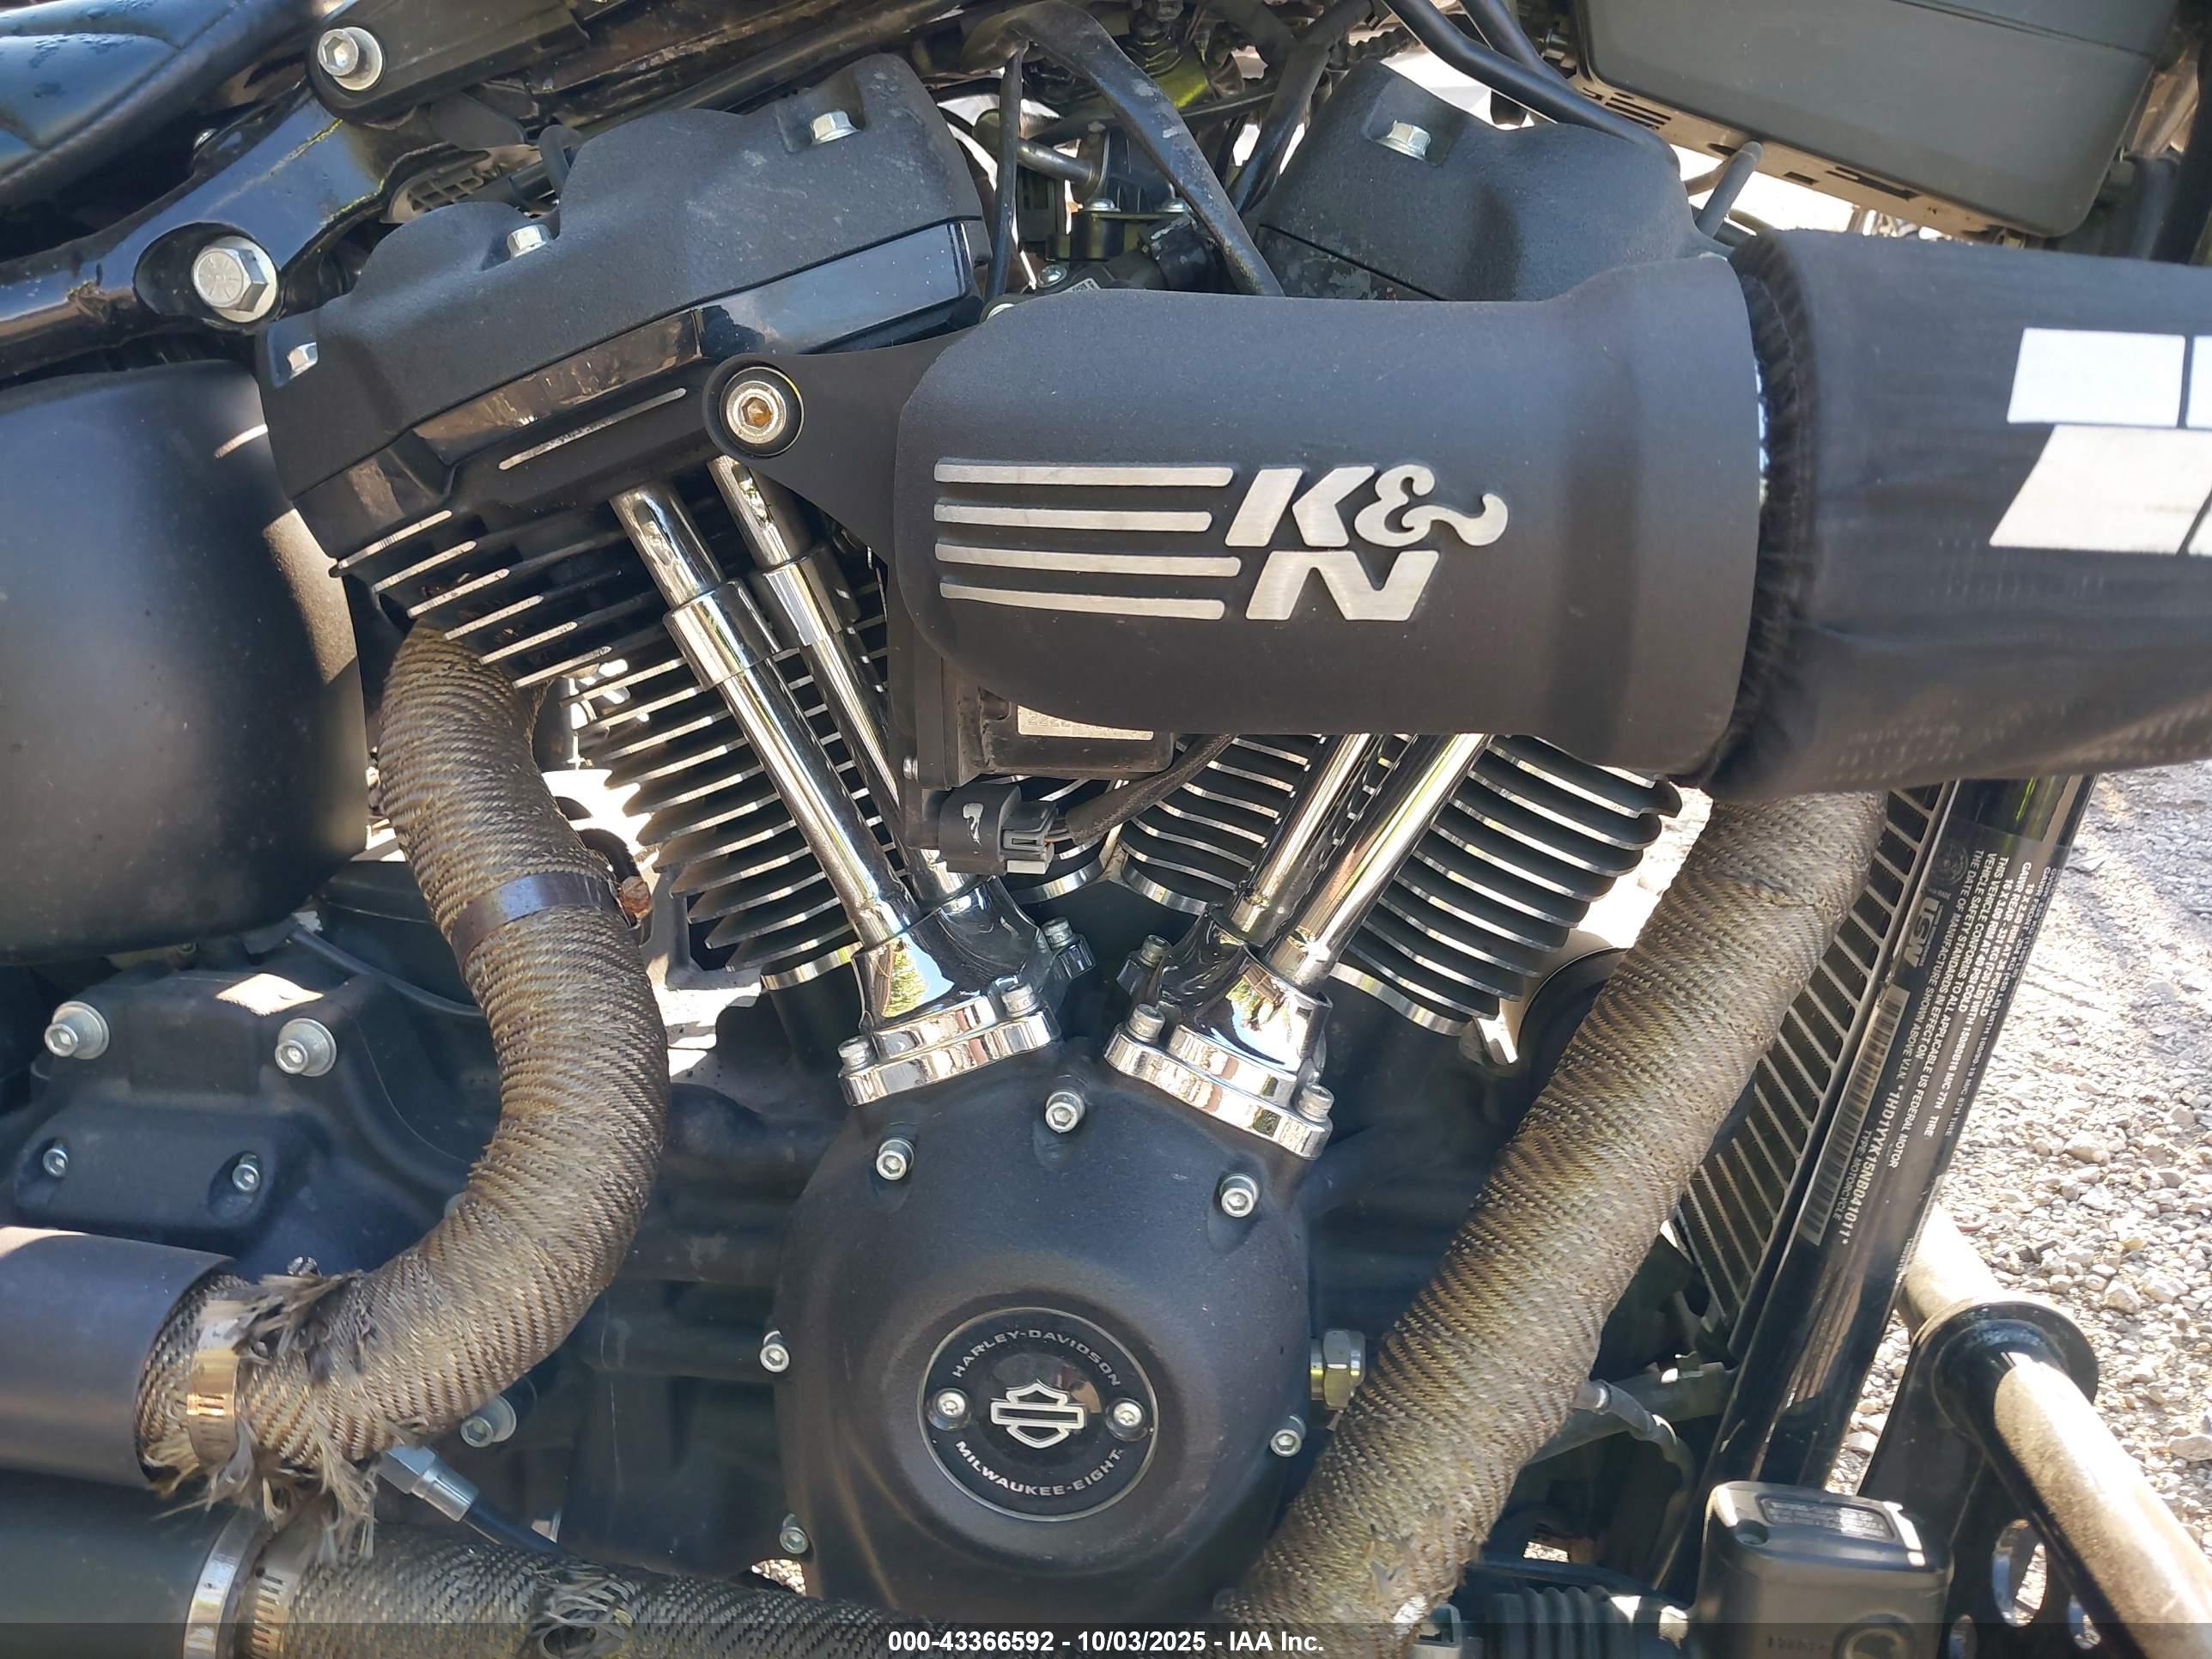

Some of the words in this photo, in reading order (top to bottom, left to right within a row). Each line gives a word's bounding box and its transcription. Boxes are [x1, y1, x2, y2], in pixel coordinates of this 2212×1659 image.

[1970, 850, 1984, 870] THE
[1993, 857, 2009, 879] THIS
[1960, 870, 1977, 897] DATE
[1974, 853, 1997, 896] VEHICLE
[2002, 878, 2014, 890] 16
[2014, 862, 2032, 893] GAWR
[2034, 866, 2051, 896] GAWR
[1999, 890, 2010, 900] X
[2025, 883, 2035, 895] 19
[1955, 897, 1967, 913] OF
[1978, 880, 2001, 922] VEHICLE
[1991, 899, 2007, 920] 3.00
[2003, 893, 2021, 921] REAR
[1961, 896, 1982, 934] SAFETY
[2014, 903, 2027, 924] 2.50
[2022, 898, 2039, 931] FRONT
[1984, 921, 1999, 940] RIM
[1995, 927, 2008, 945] 331
[2007, 925, 2020, 944] RIM
[1928, 913, 1961, 986] MANUFACTURE
[1957, 923, 1984, 979] CONFORMS
[1979, 939, 1991, 955] AT
[1989, 945, 2002, 962] KG
[2001, 944, 2013, 959] AT
[1939, 935, 1967, 994] STANDARDS
[1974, 953, 1986, 967] 40
[1968, 967, 1982, 985] PSI
[1981, 962, 1996, 982] (730
[1990, 971, 2002, 988] PSI
[1952, 981, 1965, 994] TO
[1958, 984, 1975, 1013] COLD
[1972, 982, 1988, 1000] LB)
[1915, 987, 1935, 1023] SHOWN
[1934, 994, 1946, 1006] IN
[1944, 994, 1959, 1012] ALL
[1979, 988, 1996, 1017] COLD
[1965, 1000, 1982, 1025] WITH
[1983, 1010, 1998, 1034] WITH
[1921, 1006, 1942, 1044] EFFECT
[1902, 1023, 1921, 1057] ABOVE
[1923, 1014, 1951, 1073] APPLICABLE
[1915, 1043, 1928, 1060] ON
[1917, 1074, 1930, 1088] US
[1901, 1089, 1924, 1131] FEDERAL
[1923, 1115, 1940, 1137] TIRE
[1888, 1133, 1909, 1168] MOTOR
[1832, 1157, 1863, 1221] MOTORCYCLE
[952, 1328, 1121, 1386] HARLEY-DAVIDSON
[955, 1440, 1121, 1496] MILWAUKEE-EIGHT
